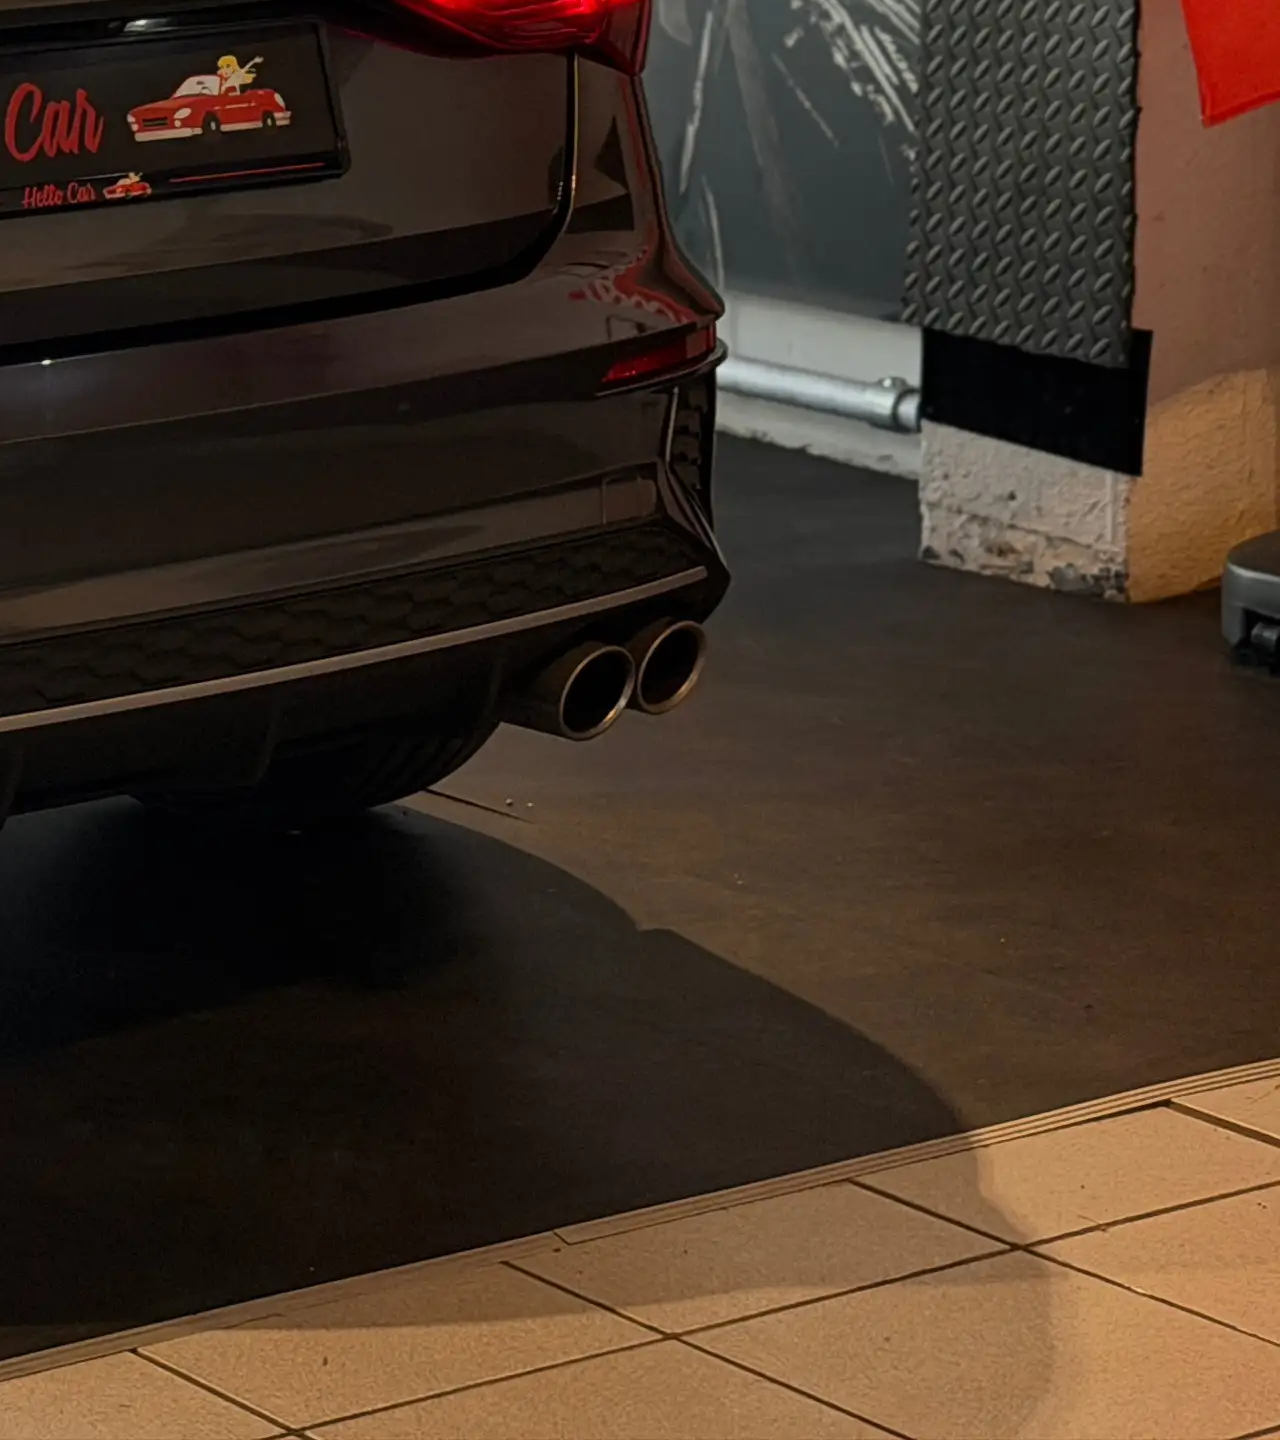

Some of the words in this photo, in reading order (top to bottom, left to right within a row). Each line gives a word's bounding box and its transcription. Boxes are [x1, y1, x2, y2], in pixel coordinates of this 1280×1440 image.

[4, 82, 105, 162] Car
[21, 184, 65, 208] Hello
[67, 182, 97, 203] Car
